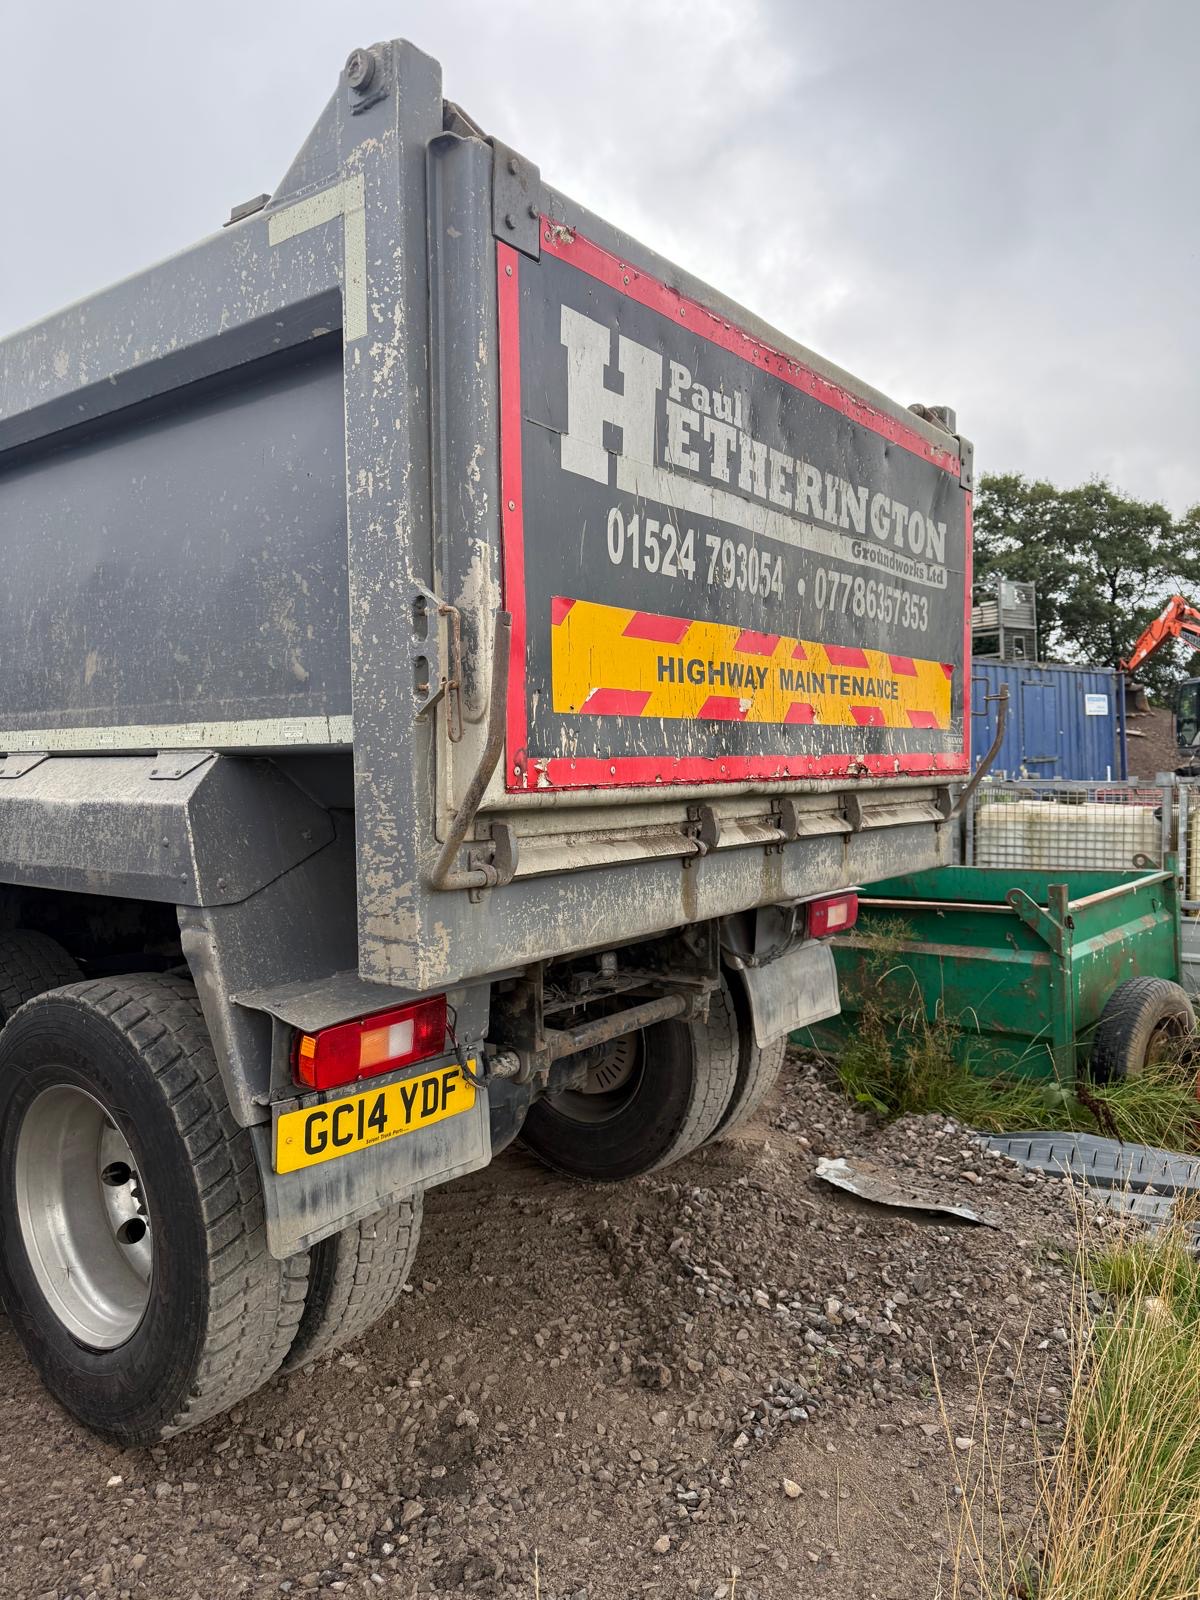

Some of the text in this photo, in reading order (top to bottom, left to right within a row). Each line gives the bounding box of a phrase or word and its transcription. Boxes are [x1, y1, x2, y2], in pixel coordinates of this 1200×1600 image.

[668, 360, 743, 427] Paul
[560, 304, 947, 564] HETHERINGTON
[607, 507, 928, 632] 01524 793054 07786357353
[851, 540, 944, 585] Groundworks Ltd
[657, 655, 899, 700] HIGHWAY MAINTENANCE
[304, 1070, 460, 1155] GC14 YDF
